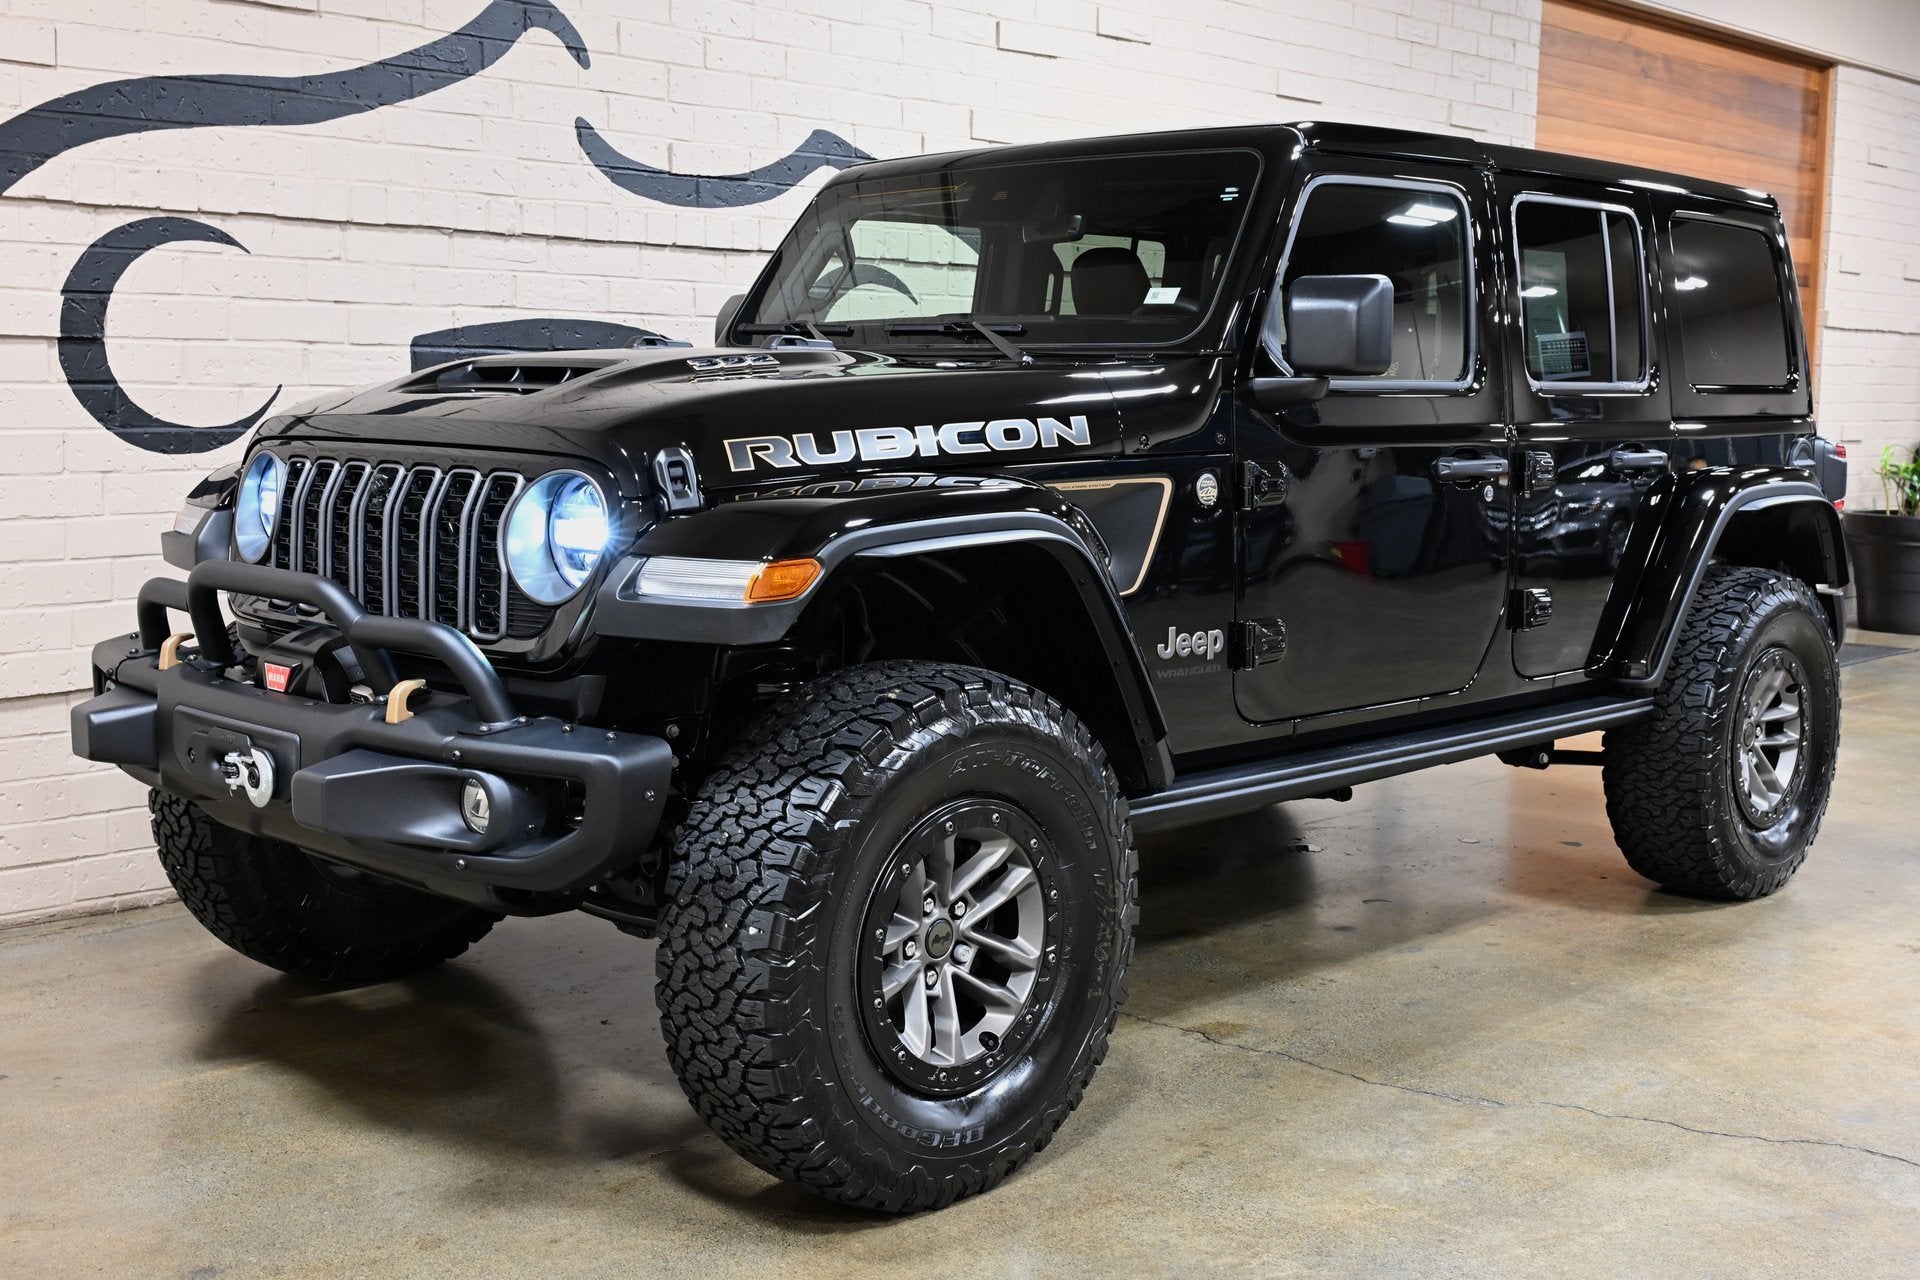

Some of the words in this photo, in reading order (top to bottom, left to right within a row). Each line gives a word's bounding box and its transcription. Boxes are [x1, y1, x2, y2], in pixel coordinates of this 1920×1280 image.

[723, 415, 1091, 472] RUBICON
[1157, 626, 1224, 660] Jeep
[1157, 665, 1221, 679] WRANGLER
